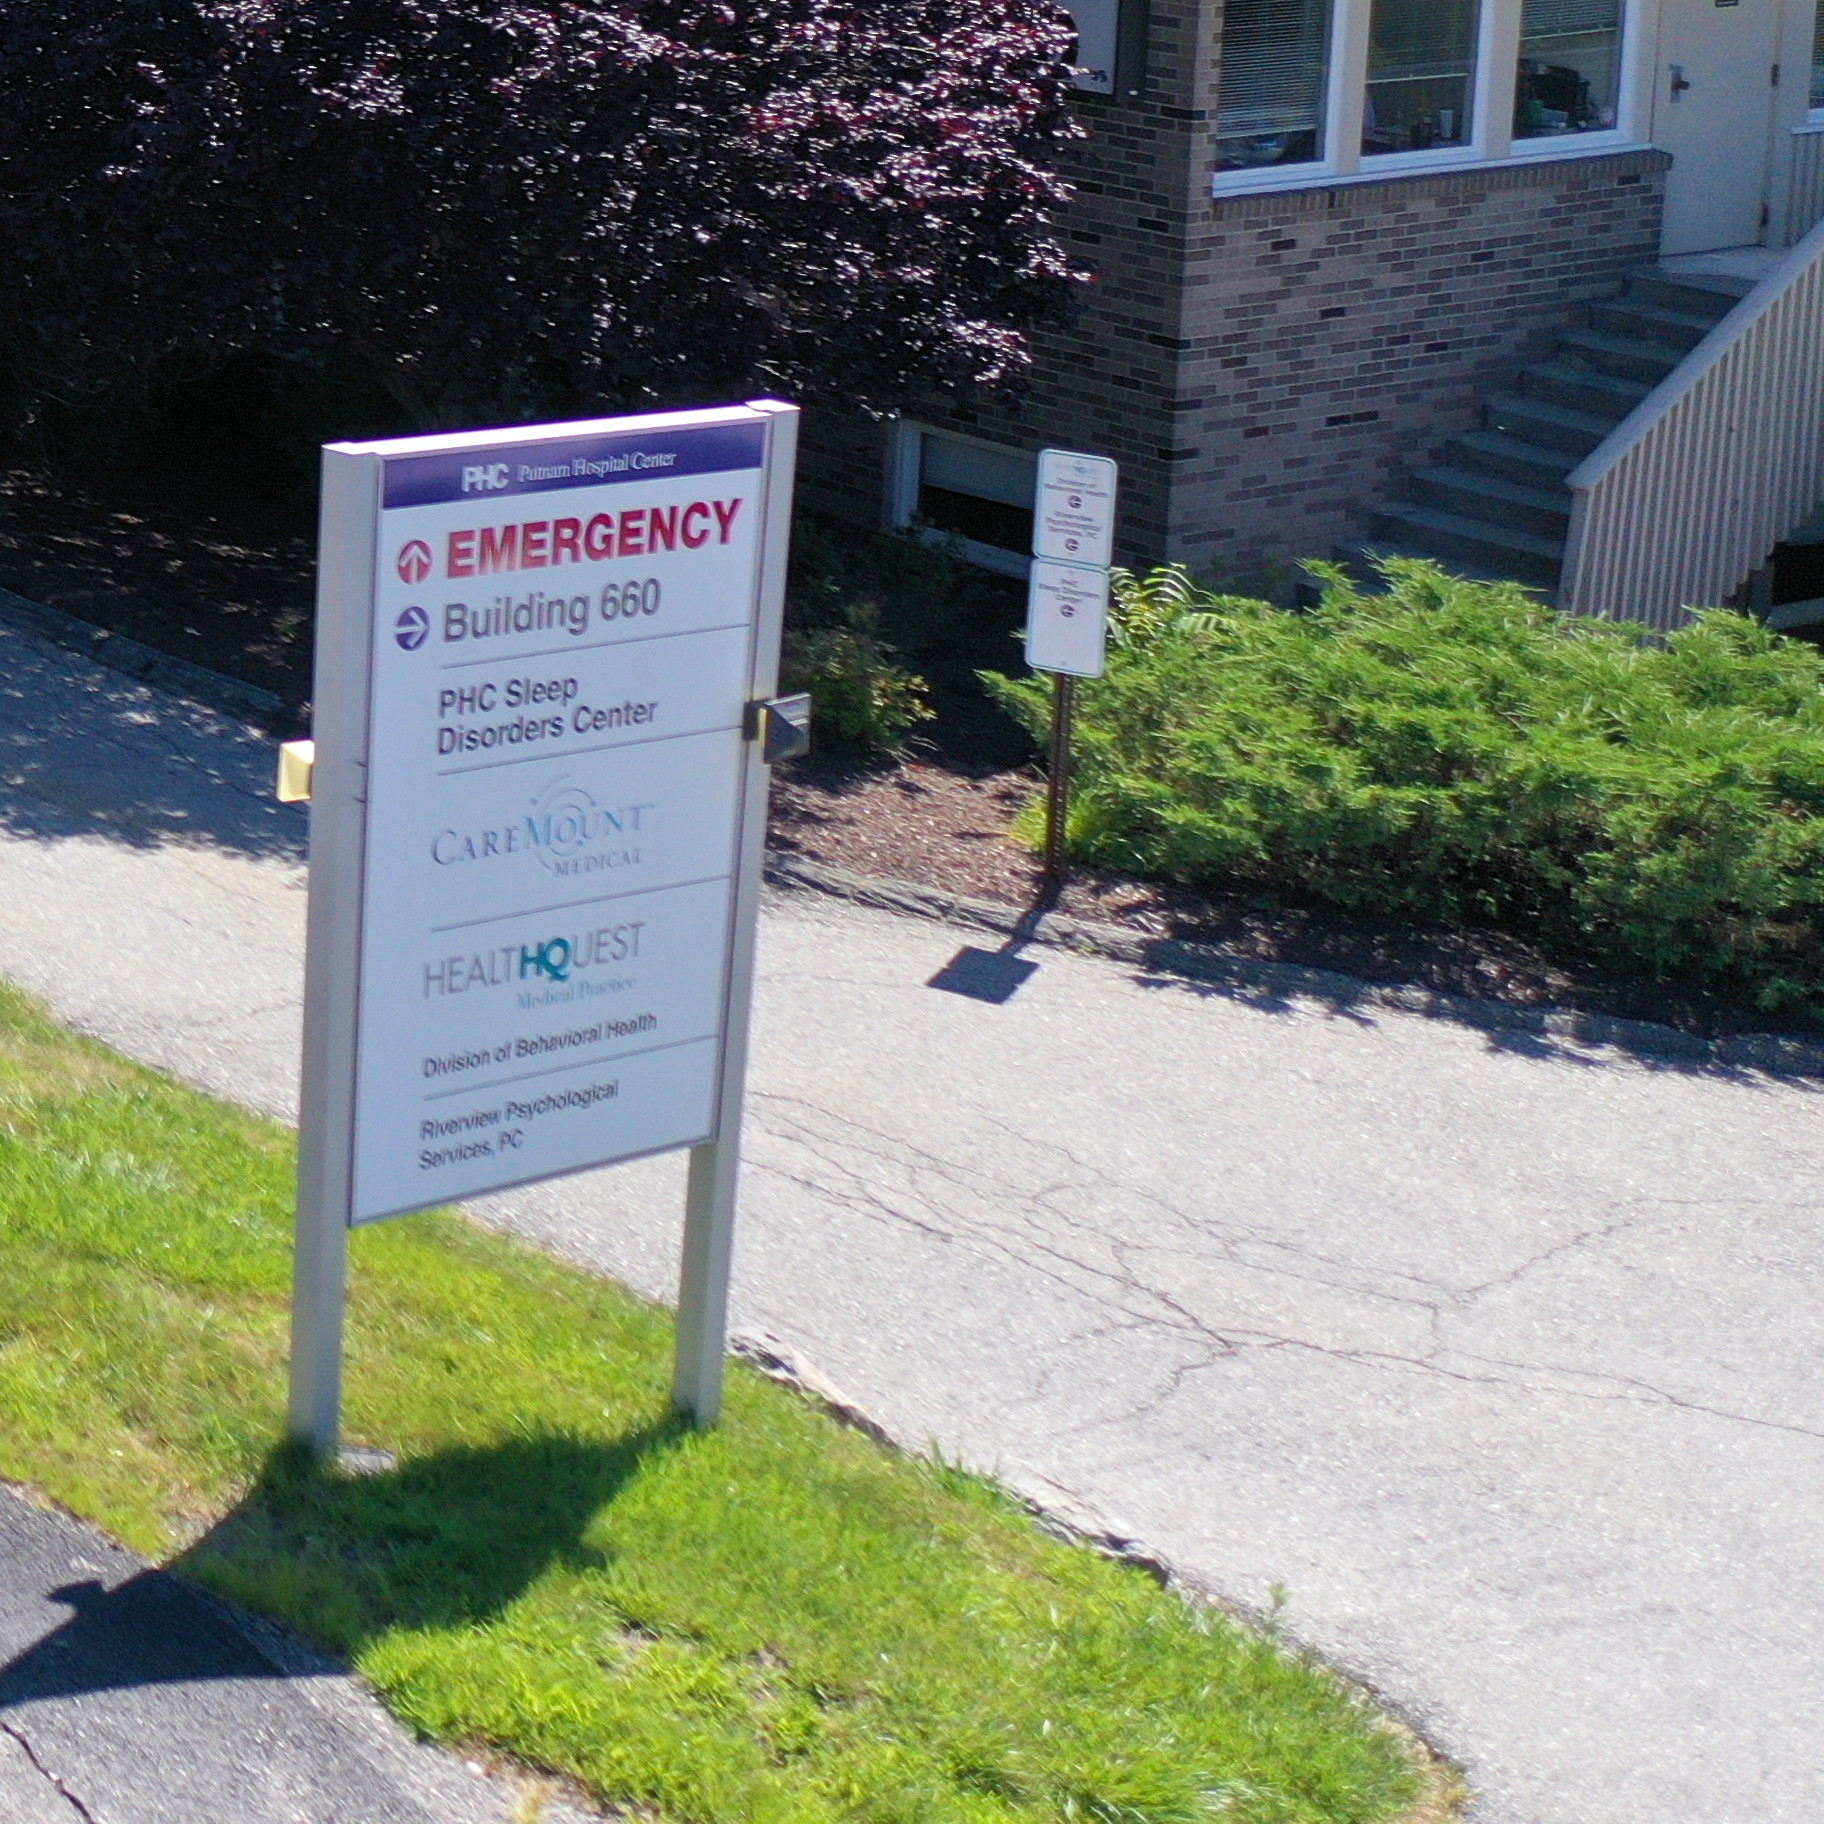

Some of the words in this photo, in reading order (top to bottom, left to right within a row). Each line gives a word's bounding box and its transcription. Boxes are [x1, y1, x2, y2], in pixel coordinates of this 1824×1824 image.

[461, 463, 509, 492] PHC
[517, 463, 571, 483] Putnam
[571, 453, 629, 479] Hospital
[632, 451, 678, 470] Center
[447, 498, 744, 580] EMERGENCY
[444, 588, 591, 644] Building
[601, 577, 662, 623] 660
[438, 681, 497, 719] PHC
[505, 677, 579, 708] Sleep
[438, 714, 565, 755] Disorders
[573, 699, 659, 734] Center
[554, 847, 643, 877] MEDICAL
[422, 921, 645, 999] HEALTHQUEST
[516, 984, 575, 1011] Medical
[580, 974, 638, 1001] Practice
[423, 1049, 491, 1078] Division
[494, 1042, 513, 1062] of
[516, 1023, 602, 1059] Behavioral
[607, 1012, 658, 1039] Health
[420, 1109, 501, 1141] Riverview
[505, 1079, 619, 1123] Psychological
[418, 1138, 495, 1170] Services,
[499, 1129, 524, 1153] PC
